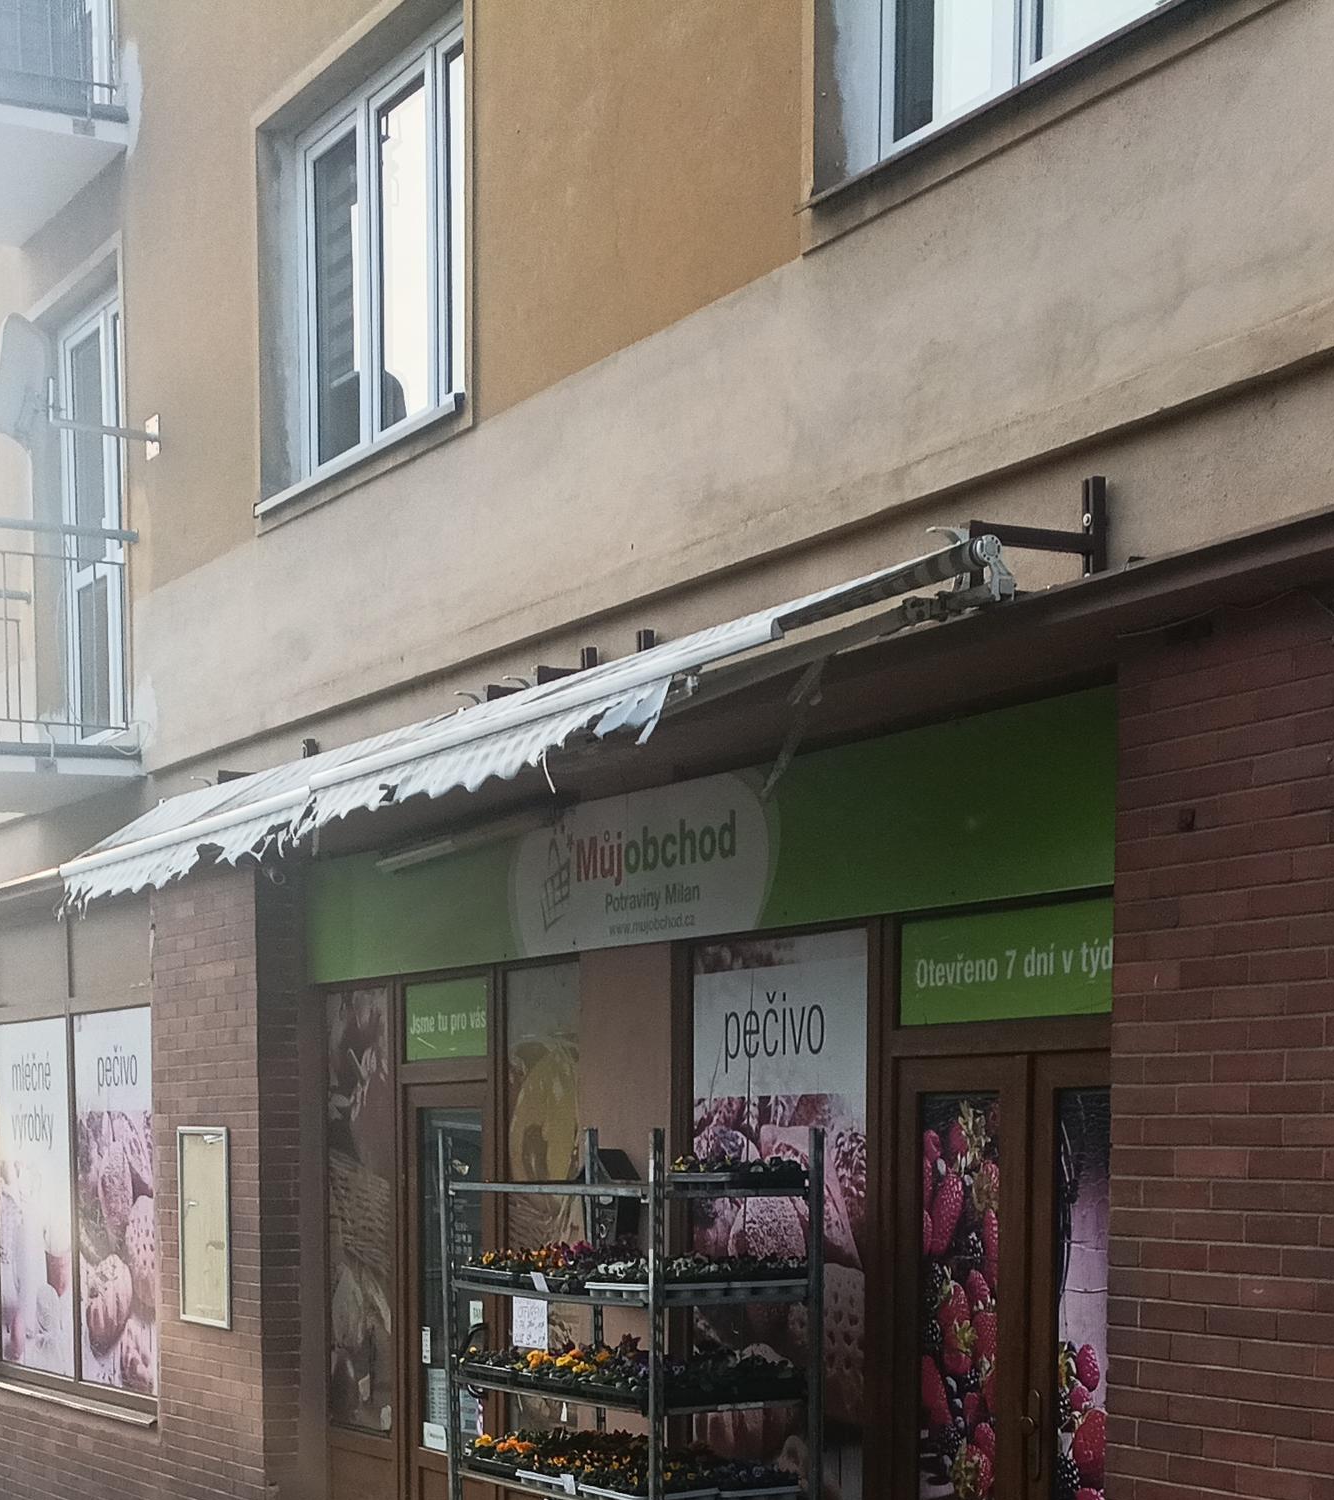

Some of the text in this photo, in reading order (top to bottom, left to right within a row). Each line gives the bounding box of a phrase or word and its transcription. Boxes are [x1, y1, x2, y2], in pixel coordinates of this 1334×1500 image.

[605, 883, 700, 914] Potraviny Milan
[917, 938, 1114, 989] Otevřeno 7 dní v týd
[410, 1006, 487, 1035] Jsme tu pro vás
[725, 990, 825, 1075] pečivo
[11, 1051, 51, 1092] mléčné
[97, 1044, 138, 1096] pečivo
[11, 1103, 54, 1150] výrobky
